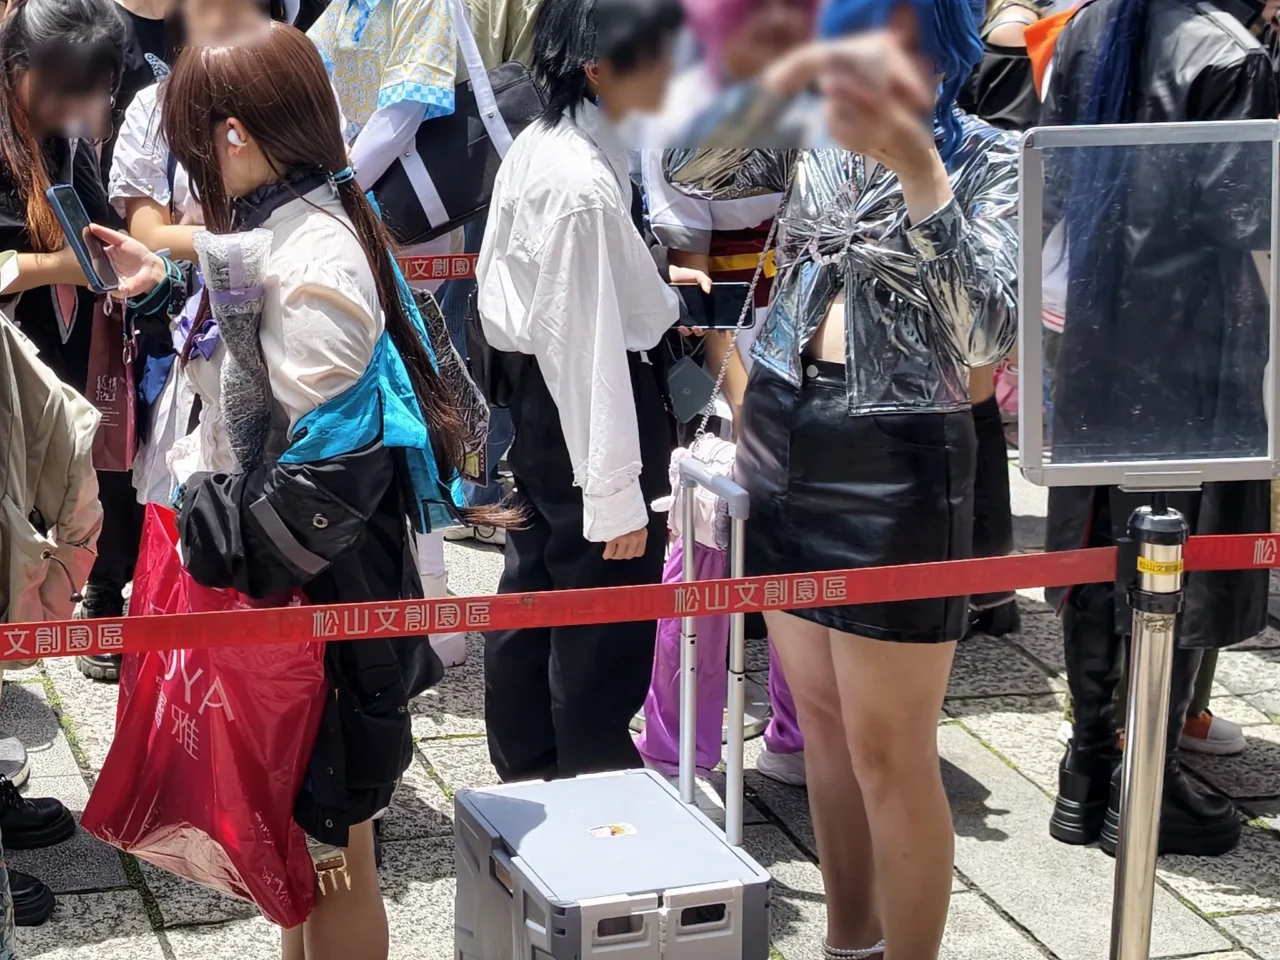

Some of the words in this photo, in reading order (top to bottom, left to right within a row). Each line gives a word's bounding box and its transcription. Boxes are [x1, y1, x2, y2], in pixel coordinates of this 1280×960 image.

[674, 575, 847, 614] 松山文創園區
[312, 601, 491, 638] 松山文創園區
